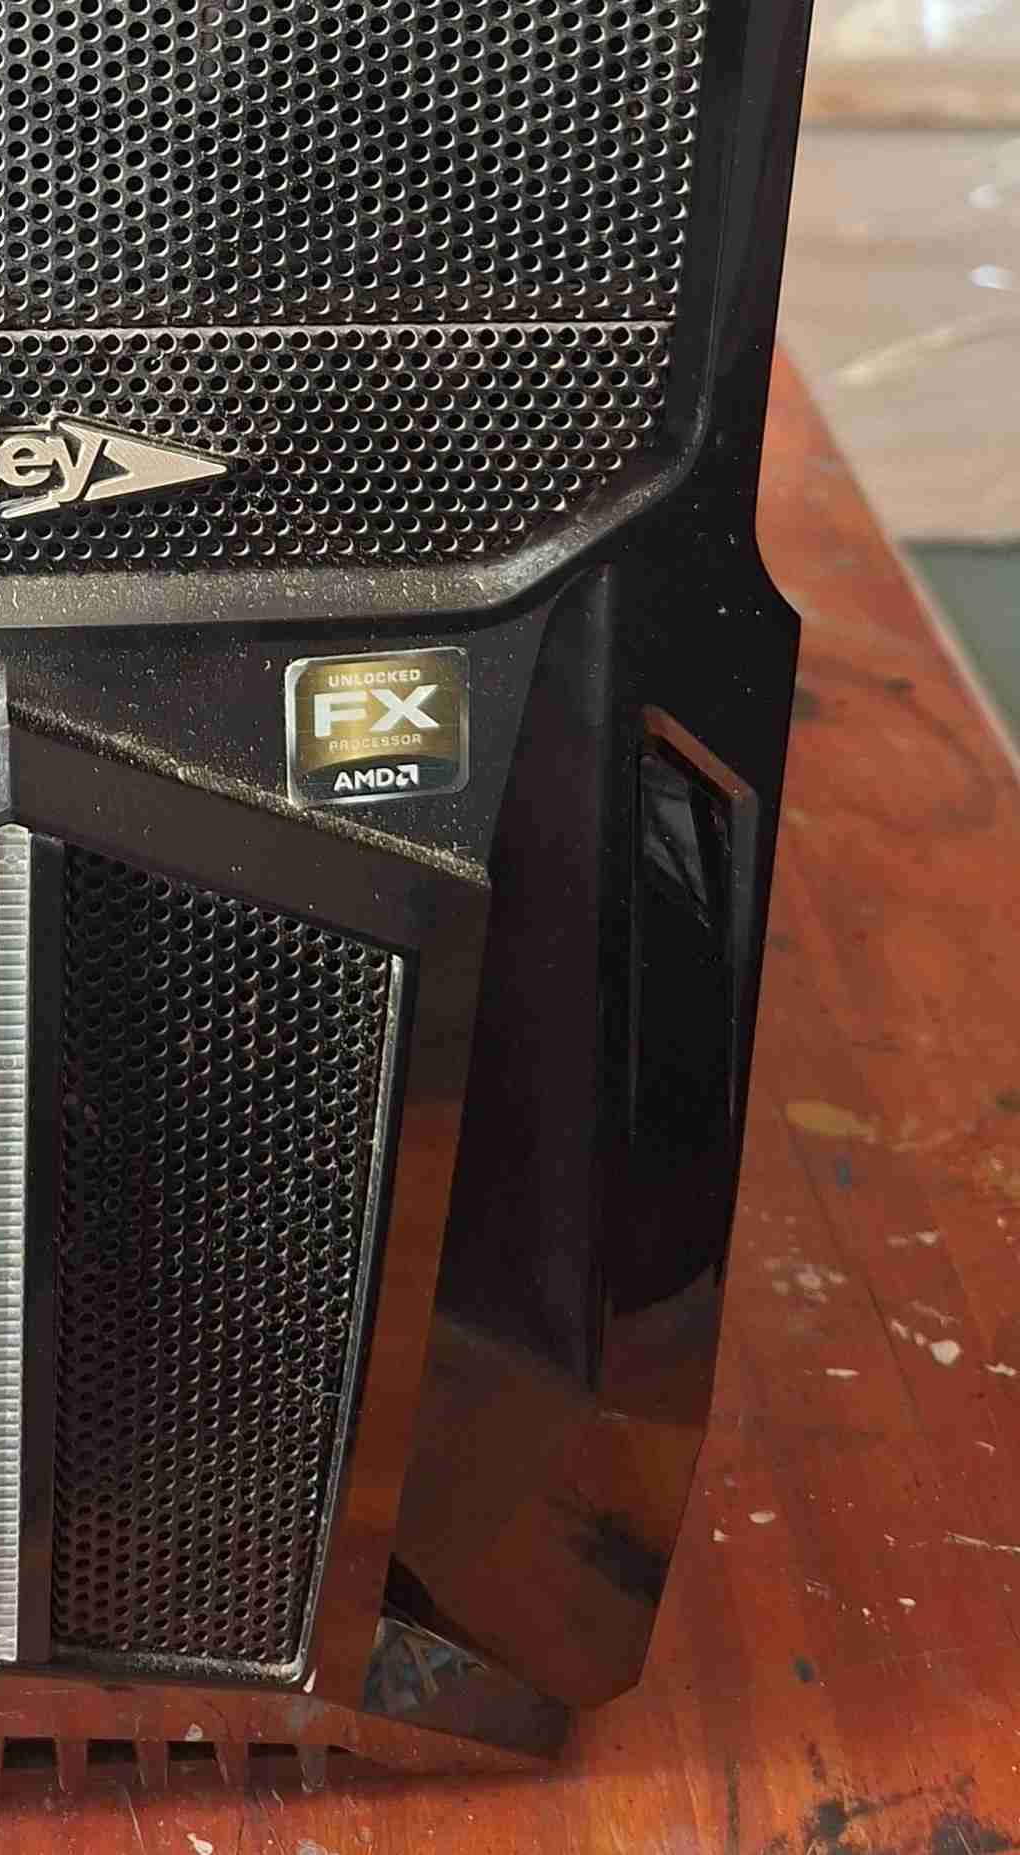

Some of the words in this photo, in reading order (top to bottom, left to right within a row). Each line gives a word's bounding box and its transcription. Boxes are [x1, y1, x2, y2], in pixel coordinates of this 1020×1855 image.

[328, 669, 421, 688] UNLOCKED
[313, 684, 440, 738] FX
[329, 733, 422, 752] PROCESSOR
[333, 767, 395, 792] AMD
